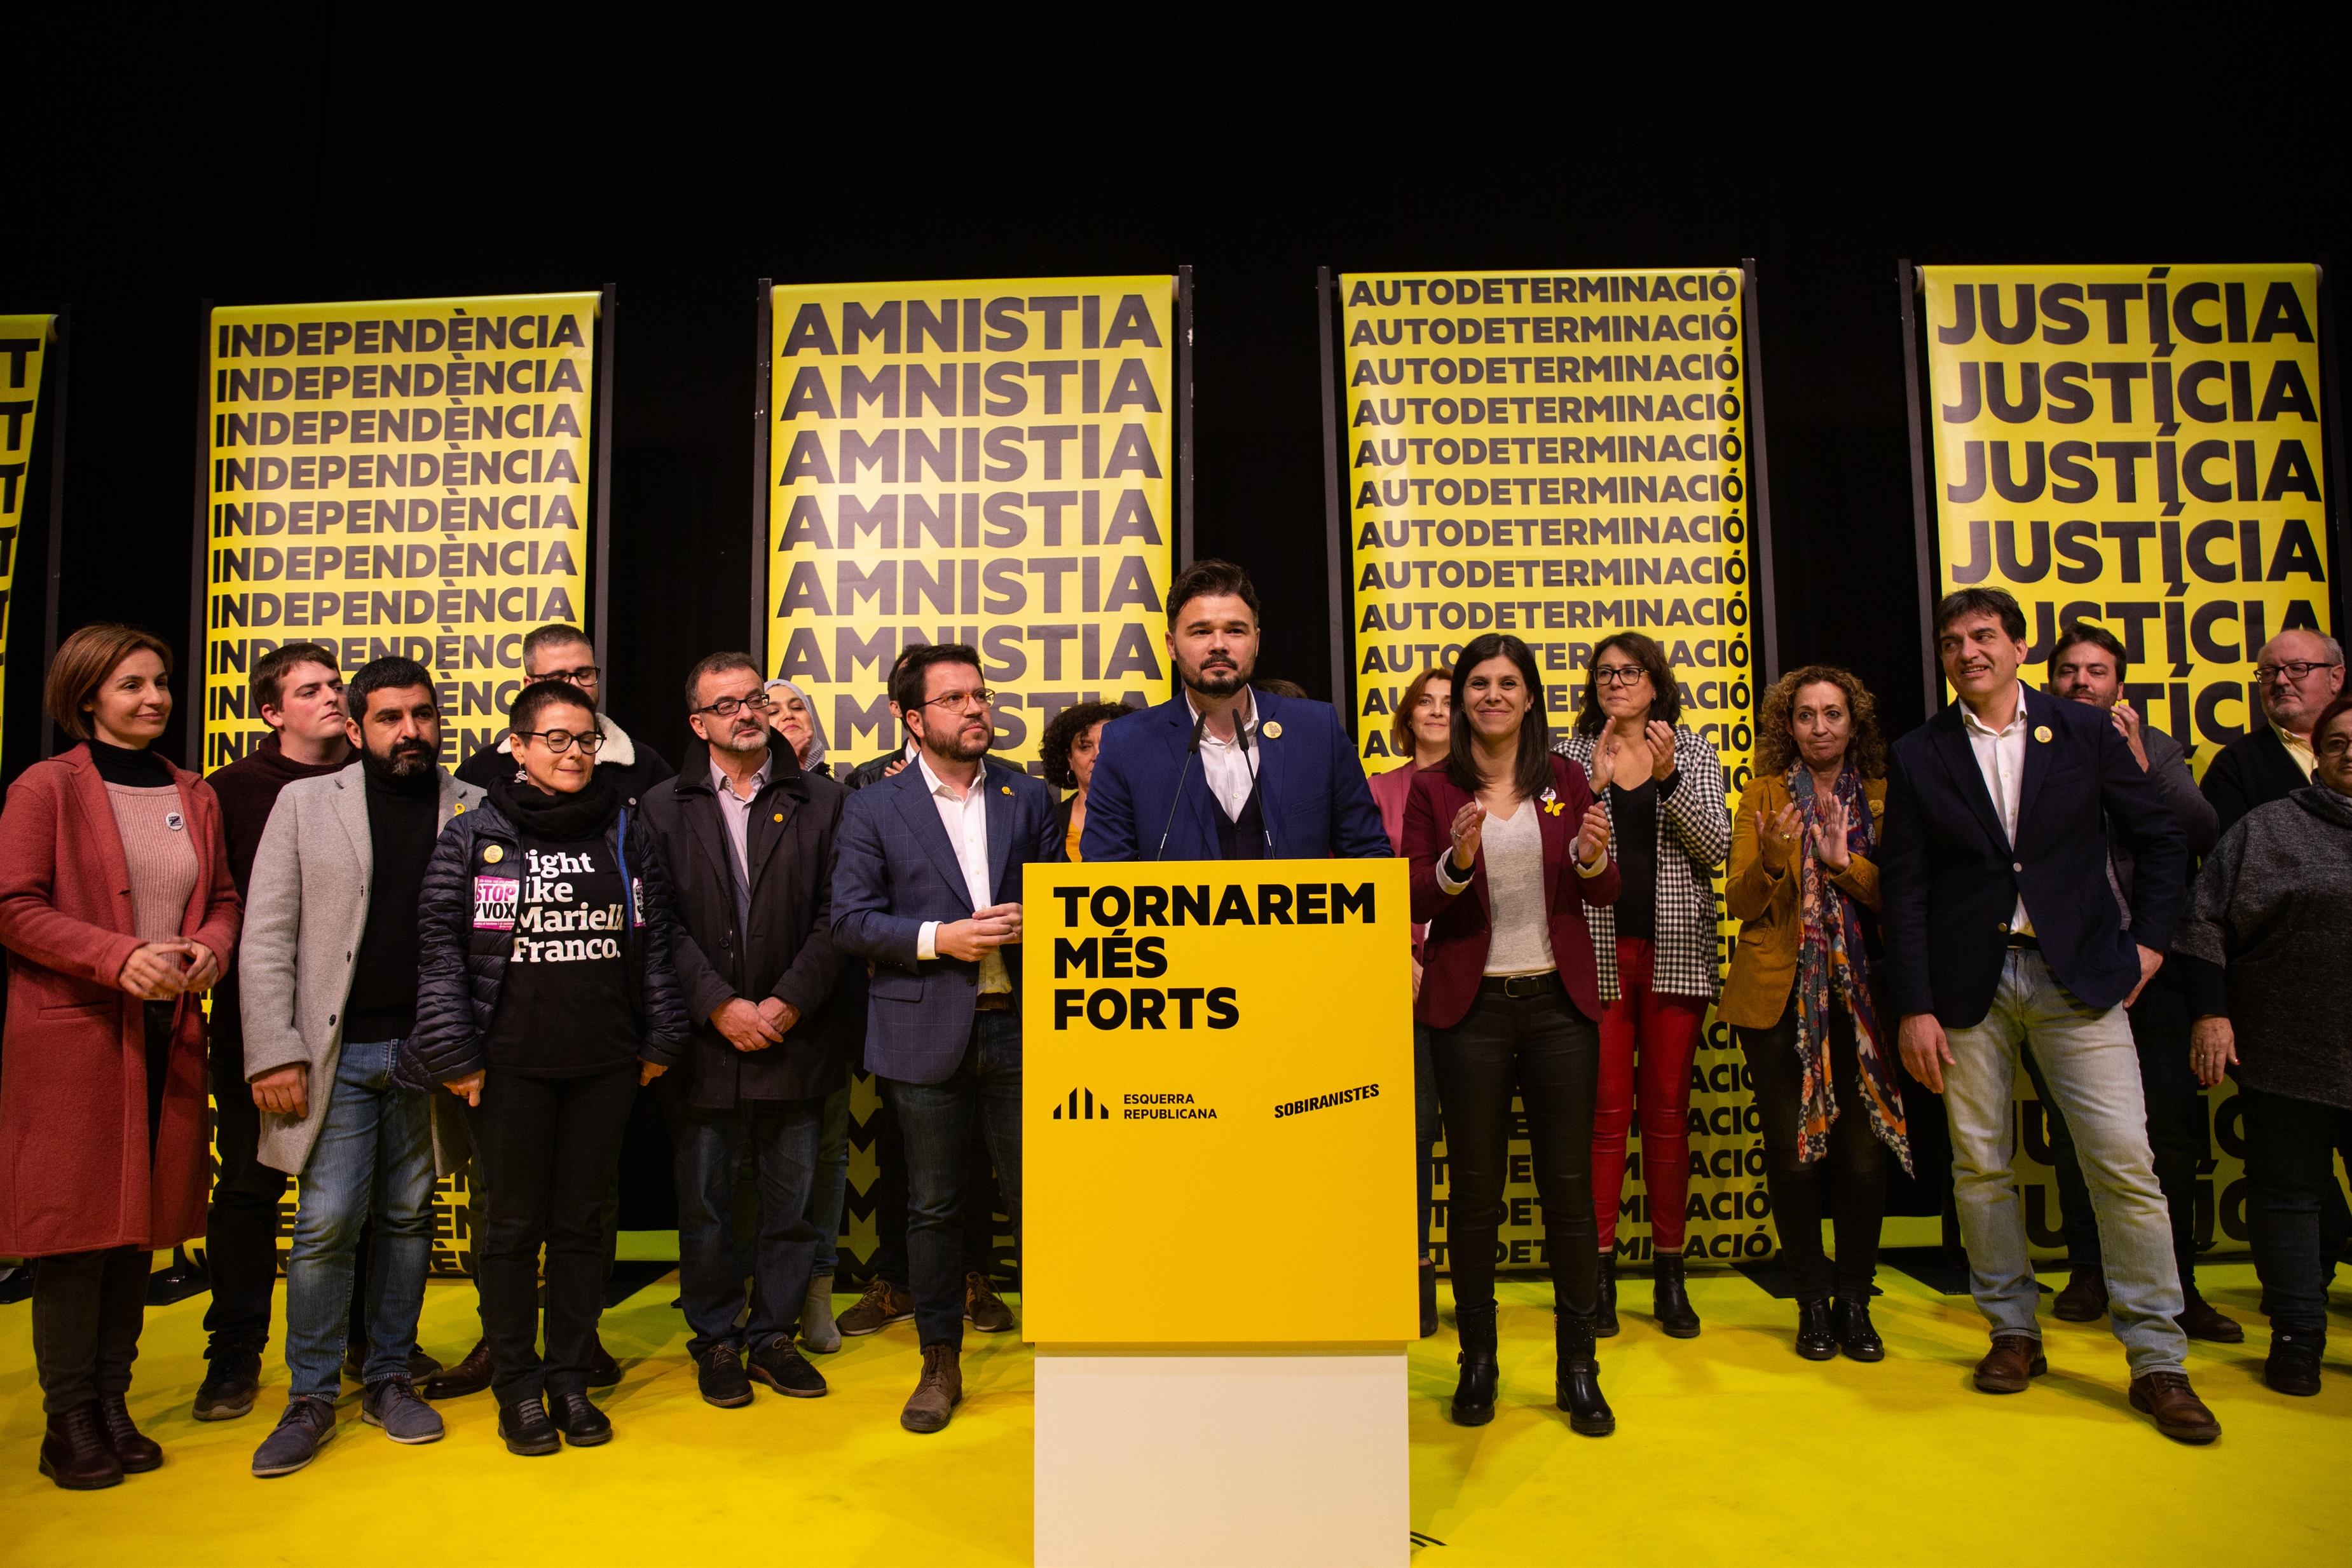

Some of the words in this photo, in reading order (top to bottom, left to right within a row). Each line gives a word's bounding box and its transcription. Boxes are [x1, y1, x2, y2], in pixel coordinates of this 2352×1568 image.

[1348, 270, 1736, 306] AUTODETERMINACIÓ
[1938, 267, 2316, 344] JUSTÍCIA
[219, 309, 584, 357] INDEPENDÈNCIA
[781, 294, 1163, 357] AMNISTIA
[1350, 308, 1738, 346] AUTODETERMINACIÓ
[218, 353, 582, 402] INDEPENDÈNCIA
[780, 358, 1163, 421] AMNISTIA
[1351, 347, 1739, 386] AUTODETERMINACIÓ
[1943, 343, 2319, 424] JUSTÍCIA
[216, 399, 581, 447] INDEPENDÈNCIA
[1353, 387, 1740, 426] AUTODETERMINACIÓ
[215, 443, 580, 492] INDEPENDÈNCIA
[779, 422, 1163, 486] AMNISTIA
[1355, 427, 1742, 467] AUTODETERMINACIÓ
[1947, 423, 2323, 503] JUSTÍCIA
[1356, 468, 1743, 508] AUTODETERMINACIÓ
[214, 488, 578, 537] INDEPENDÈNCIA
[777, 488, 1163, 551] AMNISTIA
[1357, 509, 1745, 550] AUTODETERMINACIÓ
[213, 533, 577, 582] INDEPENDÈNCIA
[1952, 503, 2327, 583] JUSTÍCIA
[776, 556, 1163, 618] AMNISTIA
[1358, 550, 1746, 590] AUTODETERMINACIÓ
[212, 580, 576, 628] INDEPENDÈNCIA
[1360, 591, 1747, 632] AUTODETERMINACIÓ
[525, 849, 596, 878] ight
[482, 903, 516, 919] VOX
[1053, 882, 1376, 927] TORNAREM
[510, 936, 621, 963] Franco.
[1054, 929, 1168, 979] MÉS
[1054, 986, 1240, 1031] FORTS
[1124, 1094, 1194, 1105] ESQUERRA
[1124, 1108, 1217, 1119] REPUBLICANA
[1275, 1084, 1379, 1119] SOBIRANISTES
